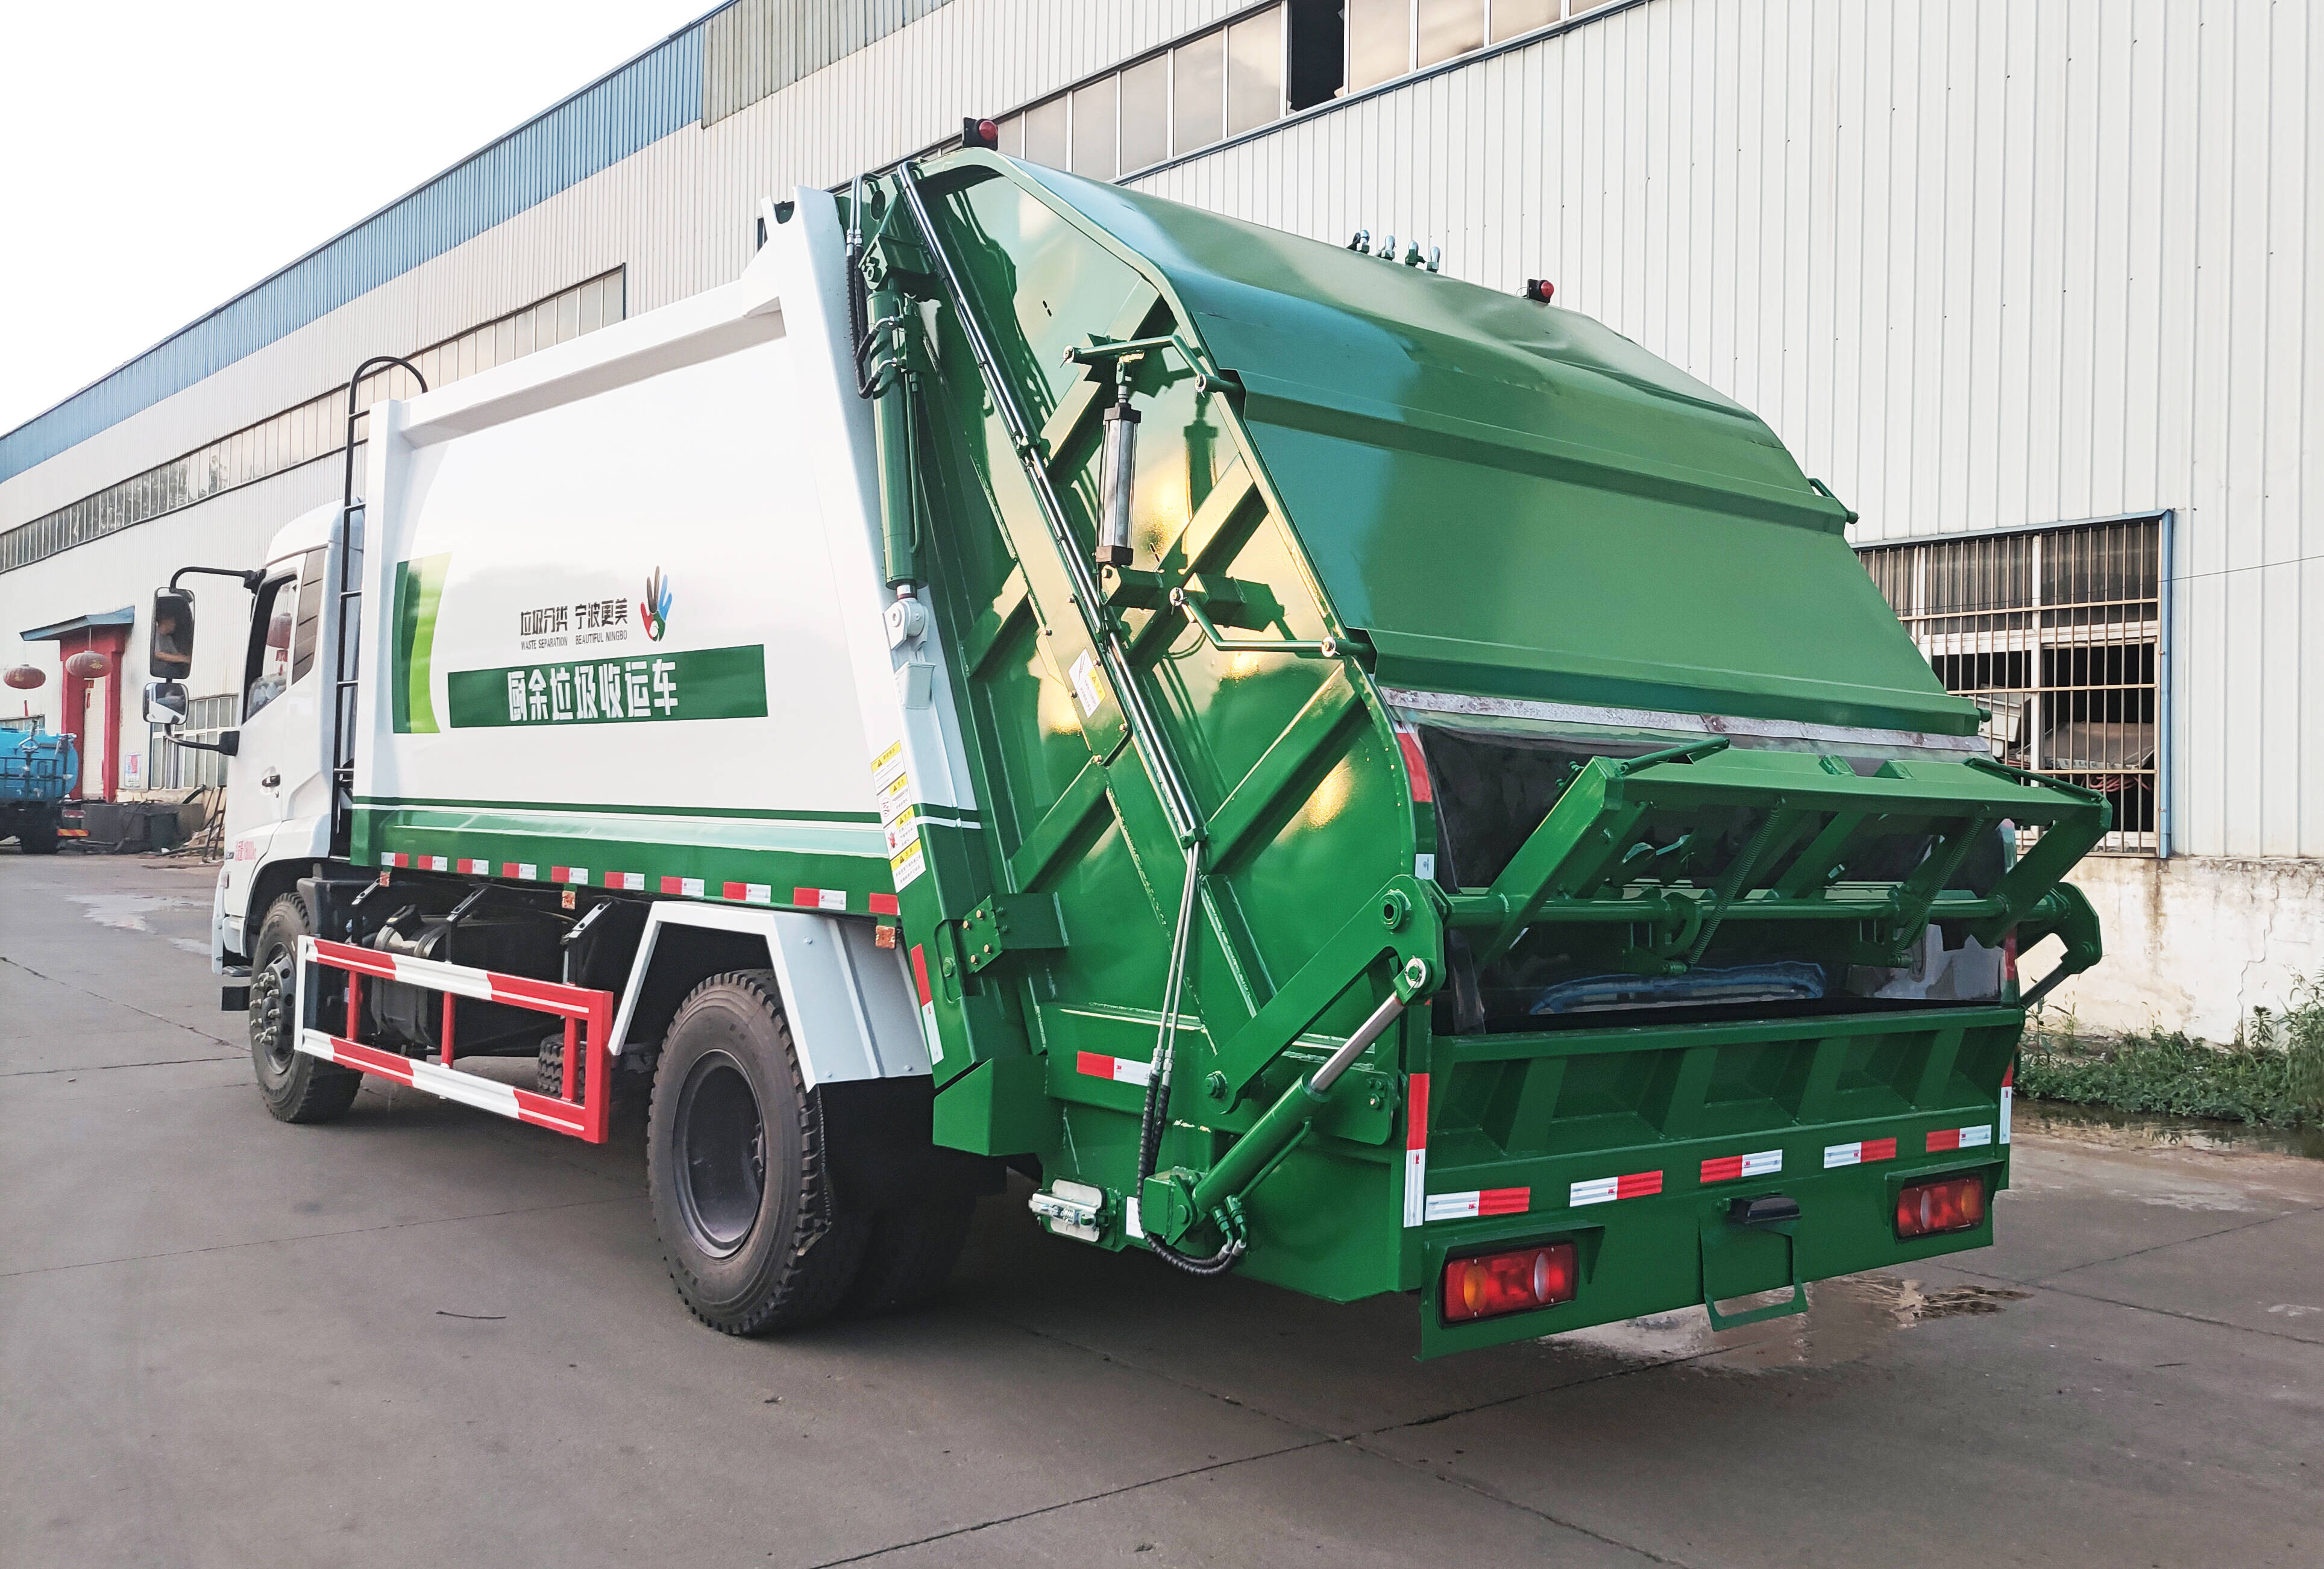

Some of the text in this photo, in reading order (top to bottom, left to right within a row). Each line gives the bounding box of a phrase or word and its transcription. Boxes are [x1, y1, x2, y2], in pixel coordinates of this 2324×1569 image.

[520, 597, 628, 636] 垃圾分类 宁波更美
[521, 630, 628, 651] WASTE SEPARATION BEAUTIFUL NINGBO
[507, 659, 679, 721] 厨余垃圾收运车
